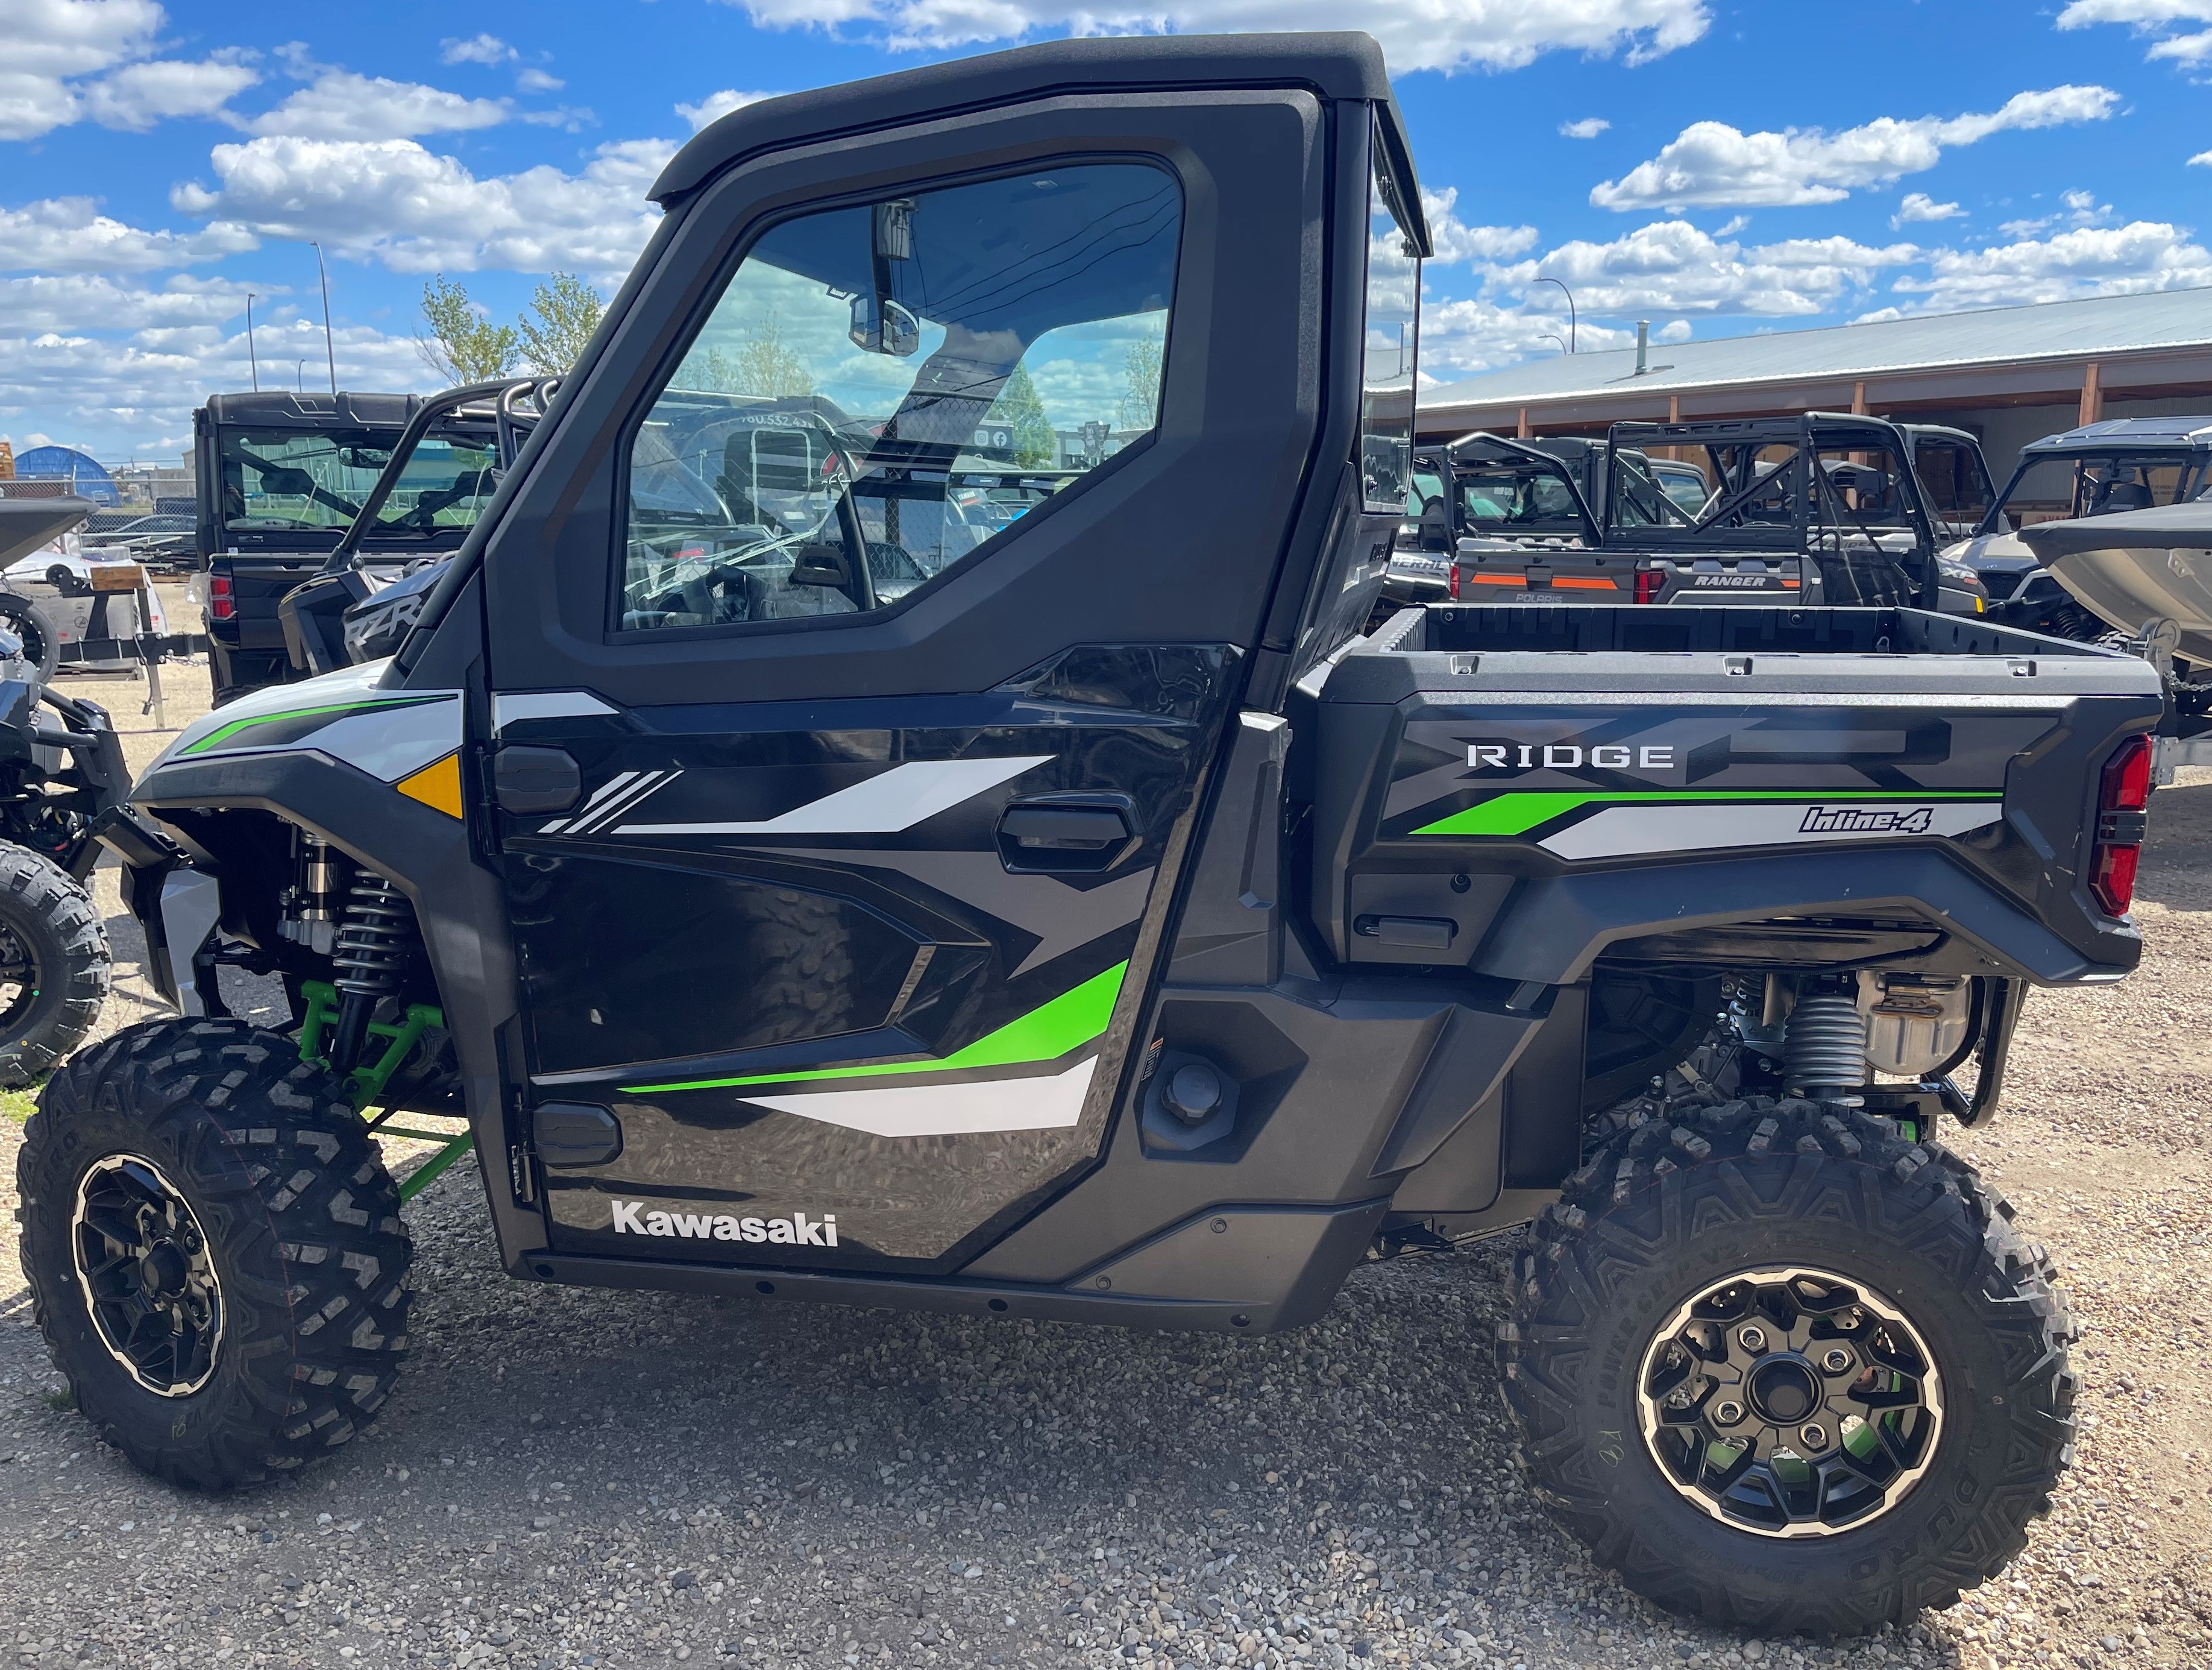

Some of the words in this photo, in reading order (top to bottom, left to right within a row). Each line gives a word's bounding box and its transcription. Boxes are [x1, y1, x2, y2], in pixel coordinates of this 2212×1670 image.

[1694, 576, 1766, 587] RANGER
[1941, 567, 1977, 579] XP
[1515, 593, 1563, 603] POLARIS
[345, 594, 422, 651] RZR
[1467, 745, 1674, 769] RIDGE
[1798, 806, 1934, 833] Inline-4
[36, 1129, 80, 1230] DURO
[611, 1200, 838, 1247] Kawasaki
[1846, 1465, 1981, 1582] DURO
